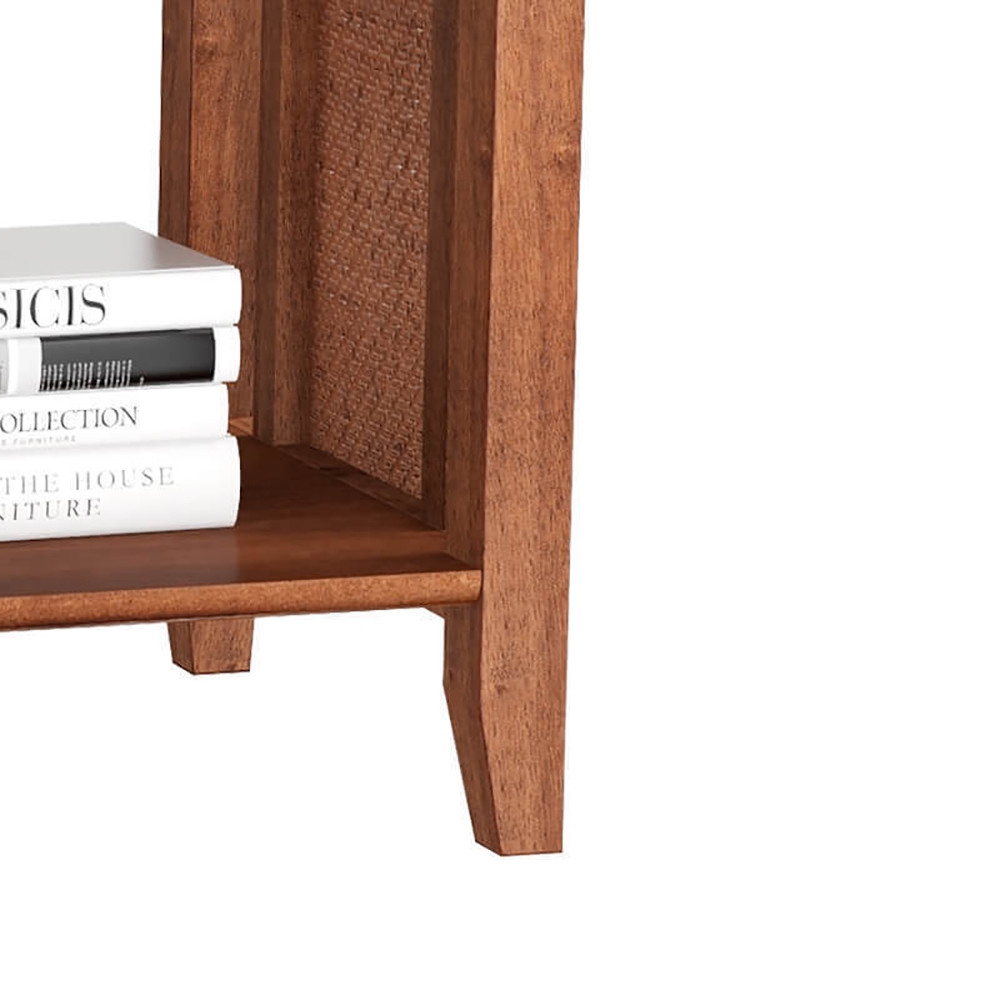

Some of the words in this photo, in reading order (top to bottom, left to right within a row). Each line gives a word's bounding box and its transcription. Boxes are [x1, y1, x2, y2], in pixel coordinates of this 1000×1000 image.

[13, 434, 77, 446] FURNITURE
[0, 472, 60, 497] THE
[74, 466, 175, 492] HOUSE
